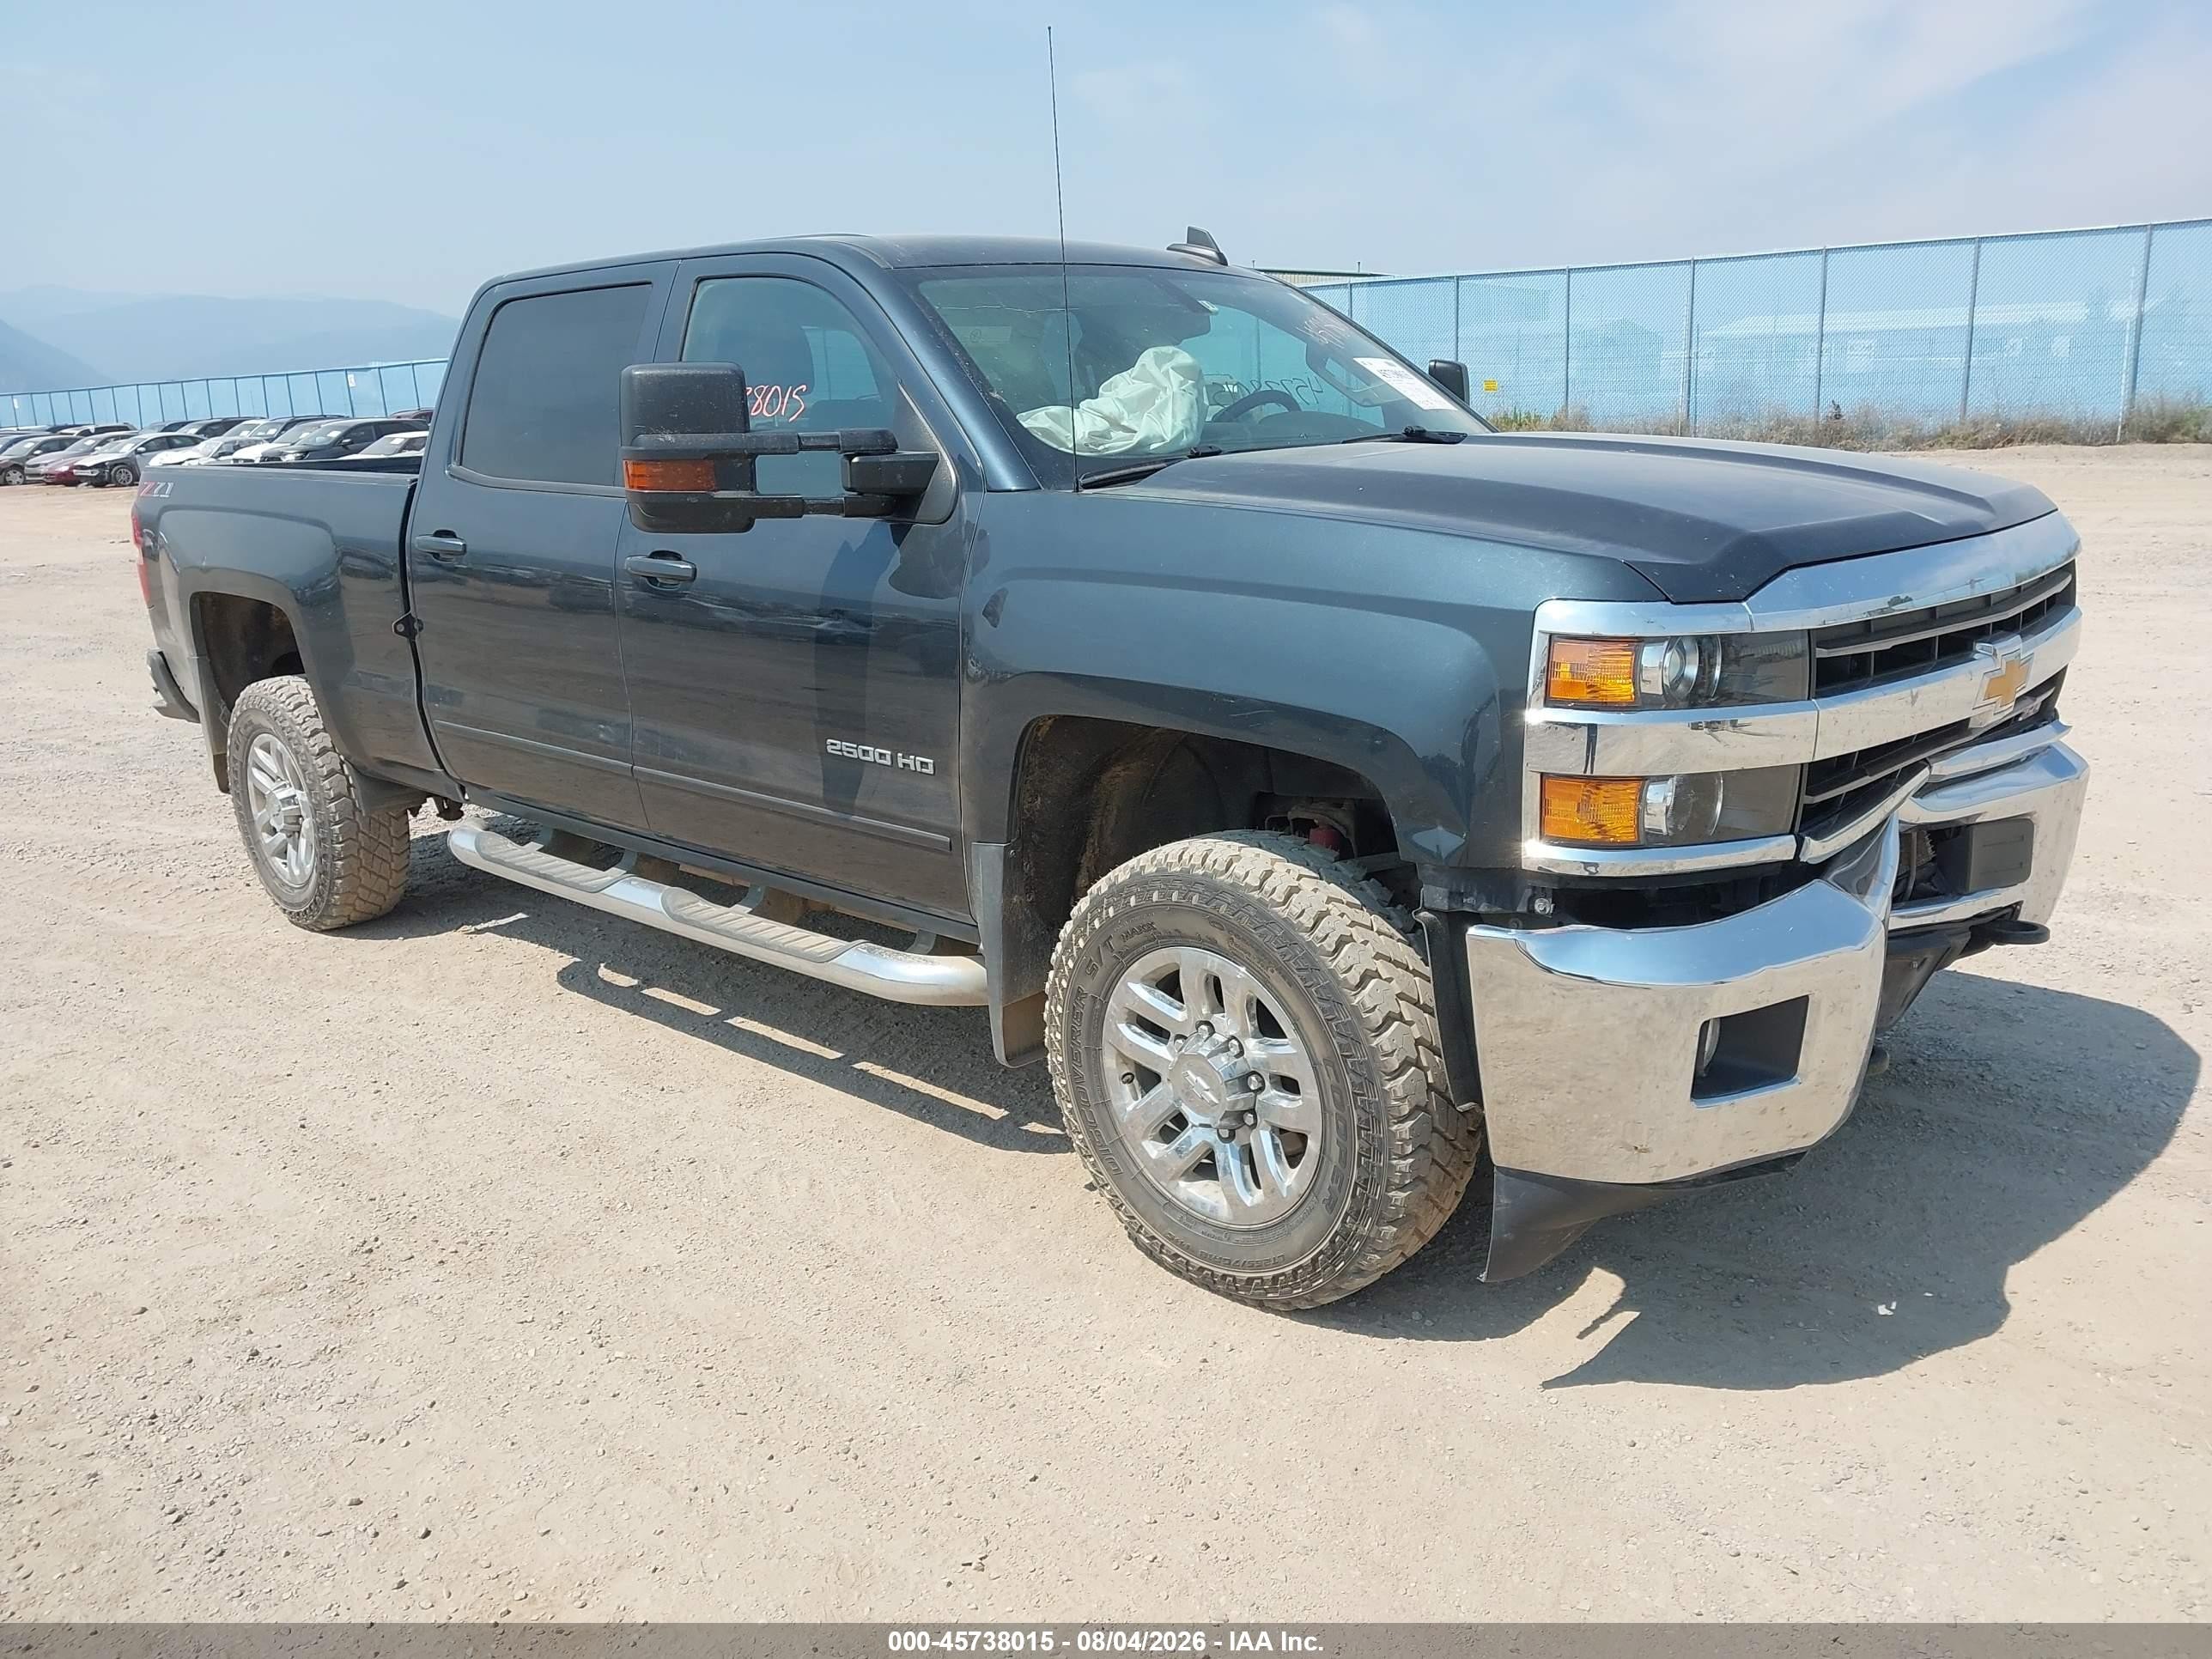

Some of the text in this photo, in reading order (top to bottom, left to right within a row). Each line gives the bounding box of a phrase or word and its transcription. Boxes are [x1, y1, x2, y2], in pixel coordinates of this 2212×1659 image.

[140, 481, 174, 498] Z71
[825, 738, 936, 775] 2500 HD
[1085, 933, 1115, 981] S/T
[1068, 984, 1124, 1176] DISCOVERER
[1322, 1057, 1349, 1215] COOPER
